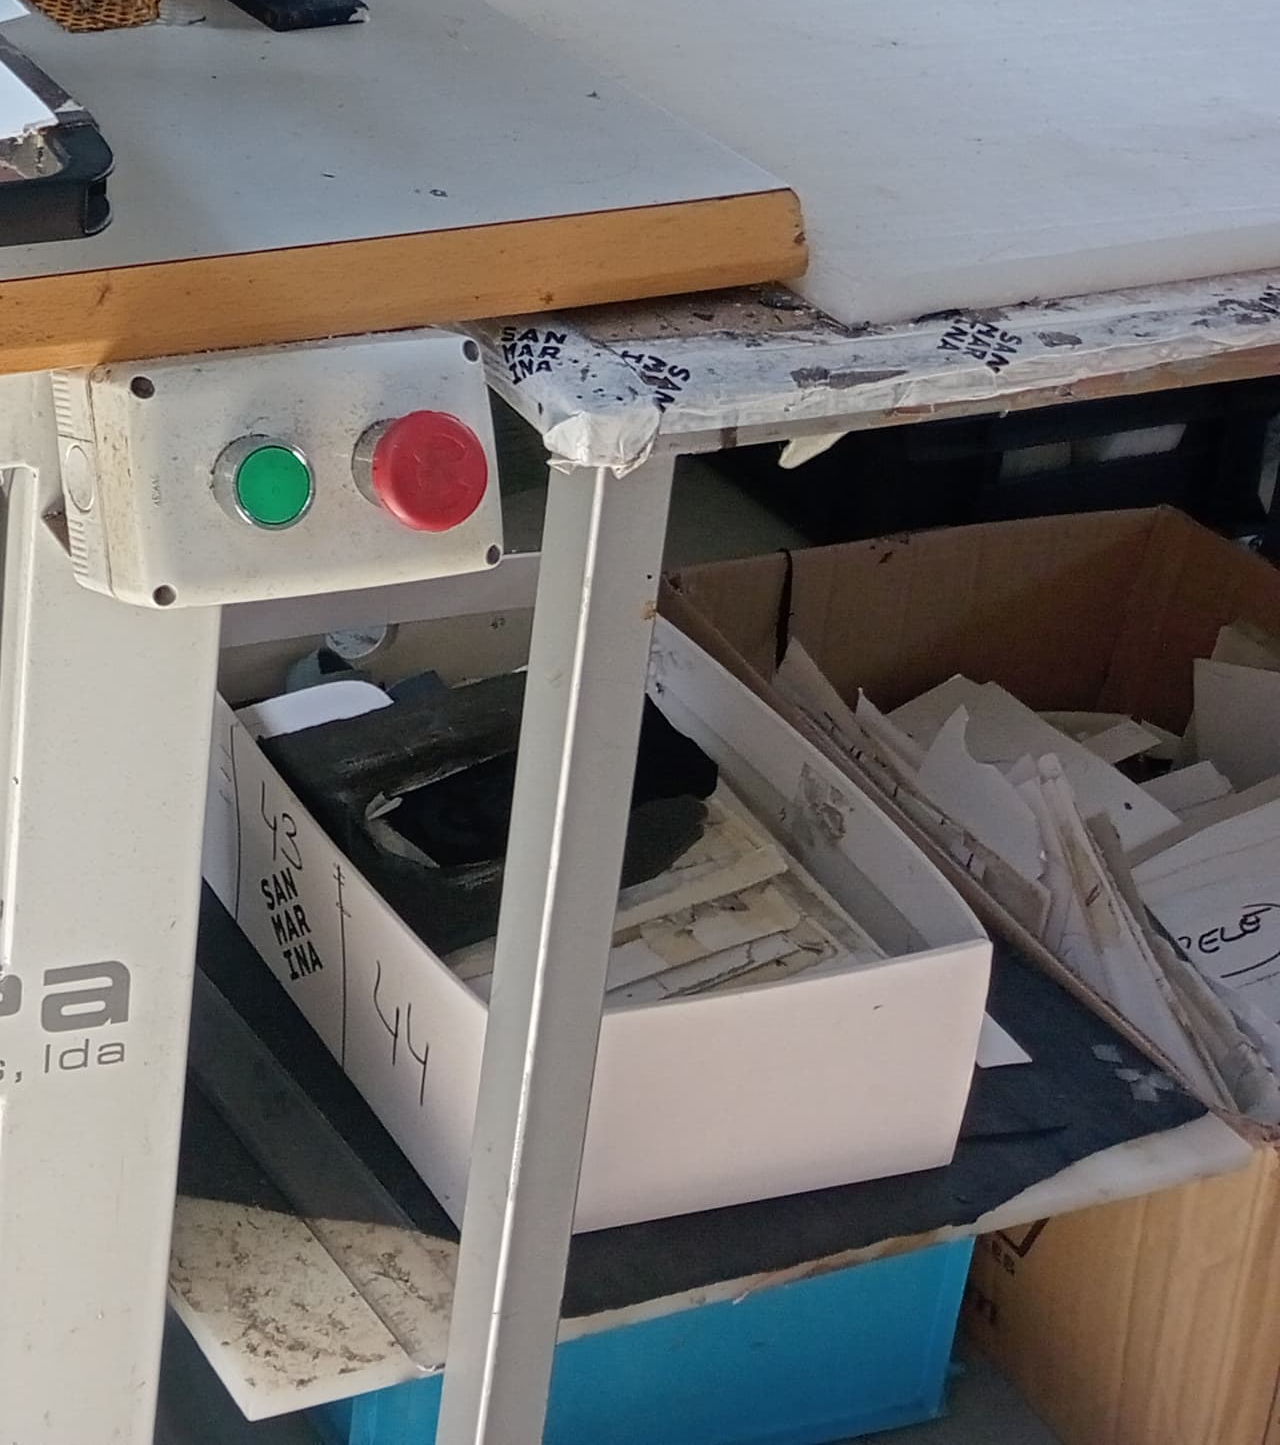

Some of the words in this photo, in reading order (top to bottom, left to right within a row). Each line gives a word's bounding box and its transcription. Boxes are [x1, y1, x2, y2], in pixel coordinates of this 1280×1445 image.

[502, 327, 568, 344] SAN
[503, 343, 561, 364] MAR
[986, 331, 1022, 374] SAN
[509, 359, 553, 385] INA
[261, 867, 299, 910] SAN
[271, 904, 312, 946] MAR
[283, 941, 324, 981] INA
[373, 959, 430, 1107] 44
